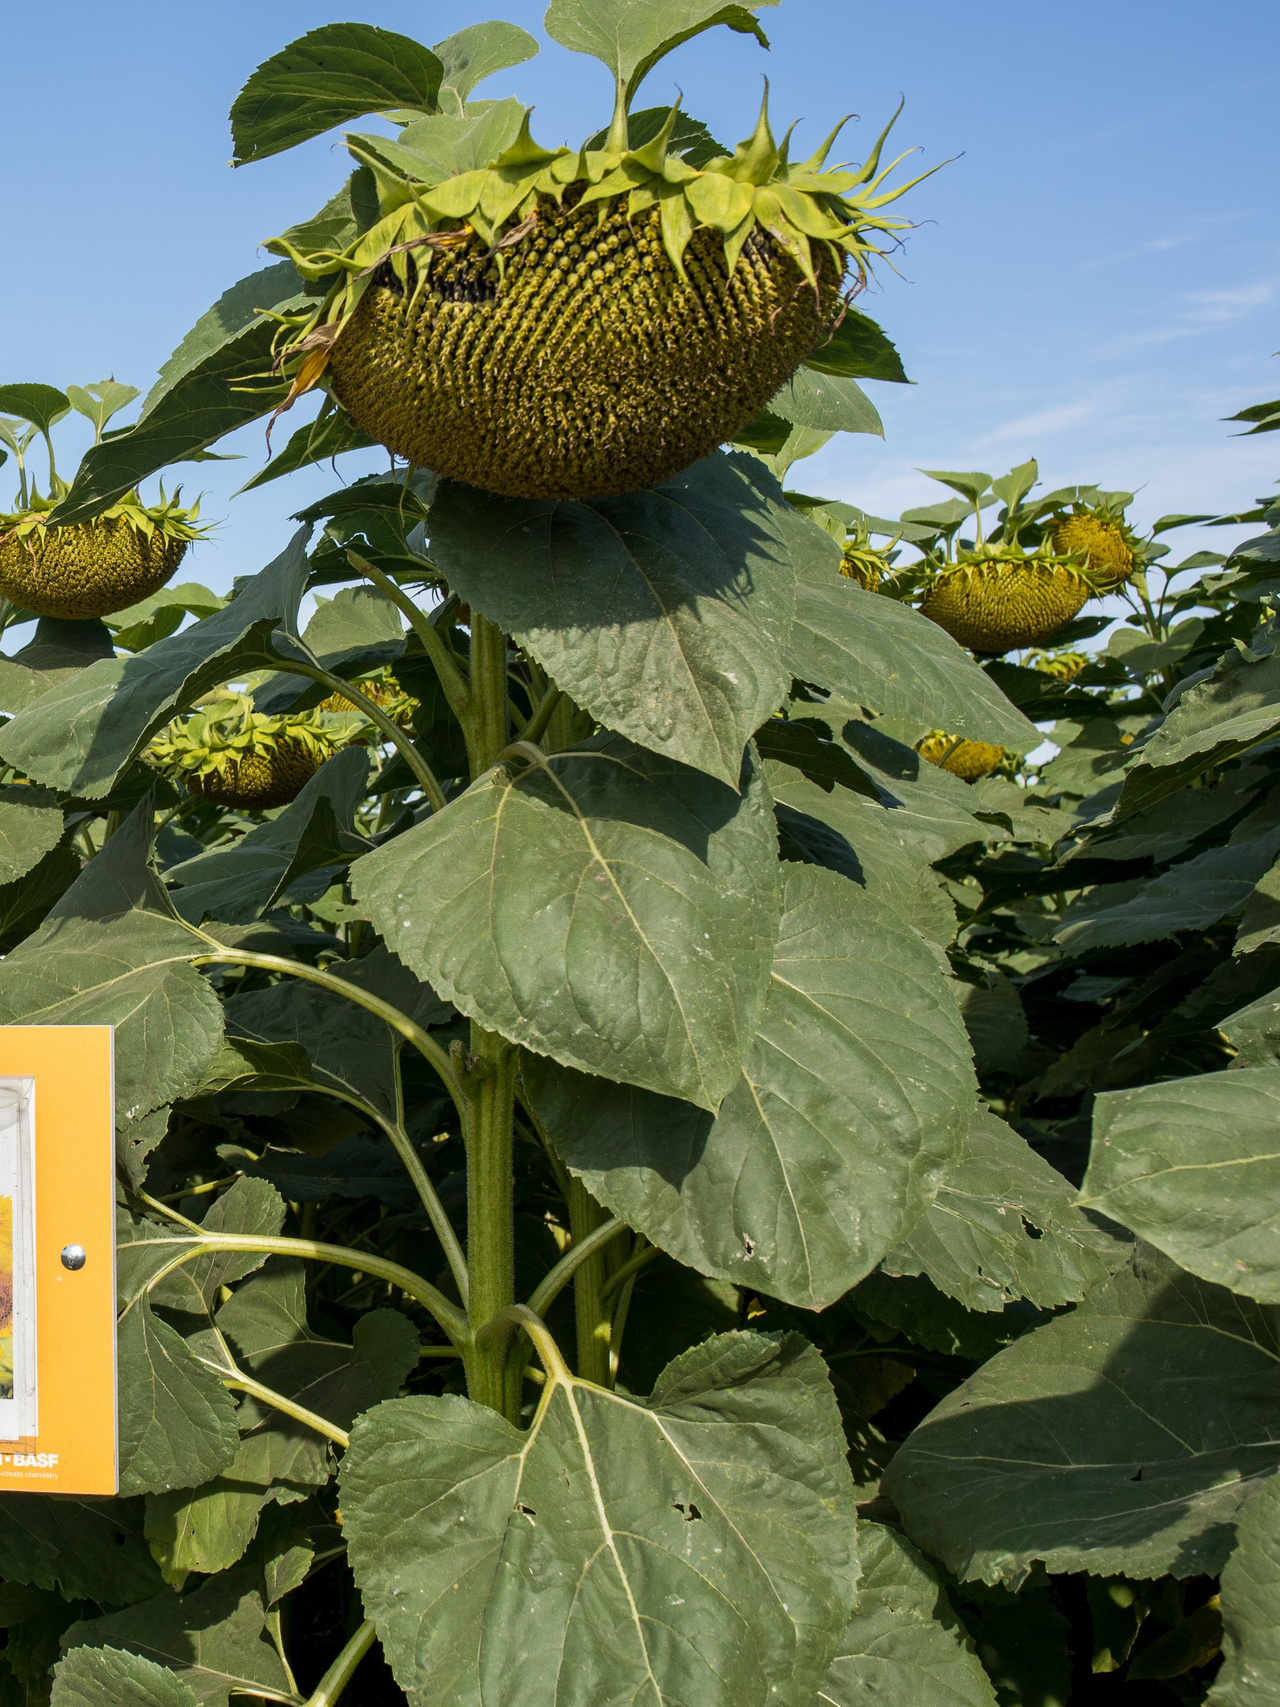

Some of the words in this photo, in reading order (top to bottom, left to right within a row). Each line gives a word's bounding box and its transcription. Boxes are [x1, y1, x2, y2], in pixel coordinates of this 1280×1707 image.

[13, 1452, 59, 1468] BASF
[2, 1470, 24, 1478] create
[24, 1471, 59, 1481] chemistry
